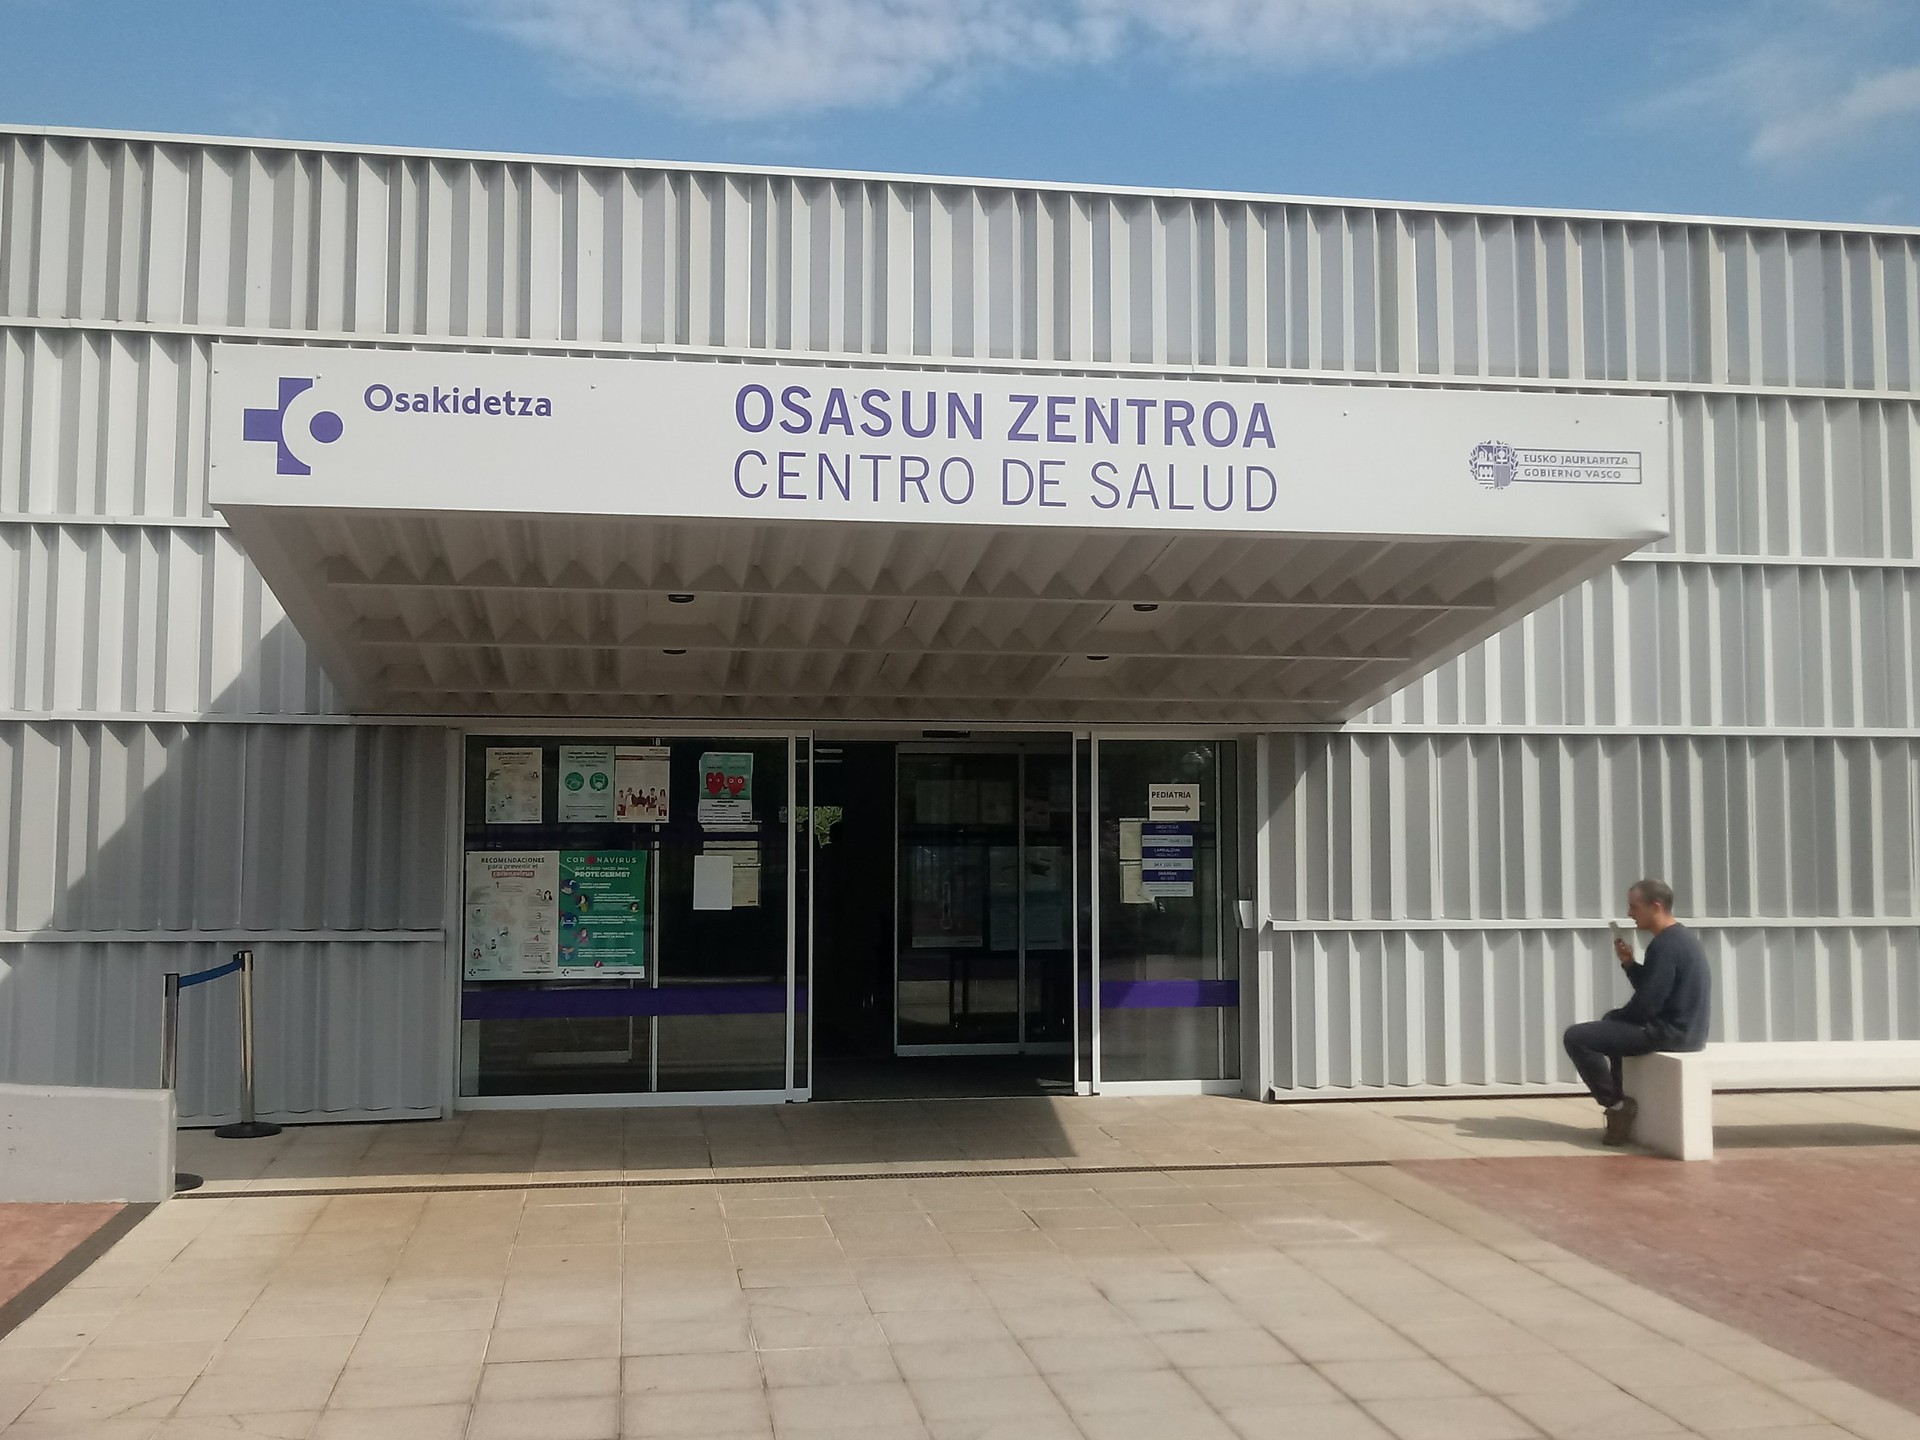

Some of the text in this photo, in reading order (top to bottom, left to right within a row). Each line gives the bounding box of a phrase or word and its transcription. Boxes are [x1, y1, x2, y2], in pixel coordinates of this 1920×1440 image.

[363, 383, 553, 417] Osakidetza
[735, 384, 1276, 449] OSASUN ZENTROA
[1523, 454, 1628, 465] EUSKO JAURLARITZA
[733, 449, 1278, 512] CENTRO DE SALUD
[1524, 468, 1621, 479] GOBIERNO VASCO
[1151, 791, 1191, 799] PEDIATRIA
